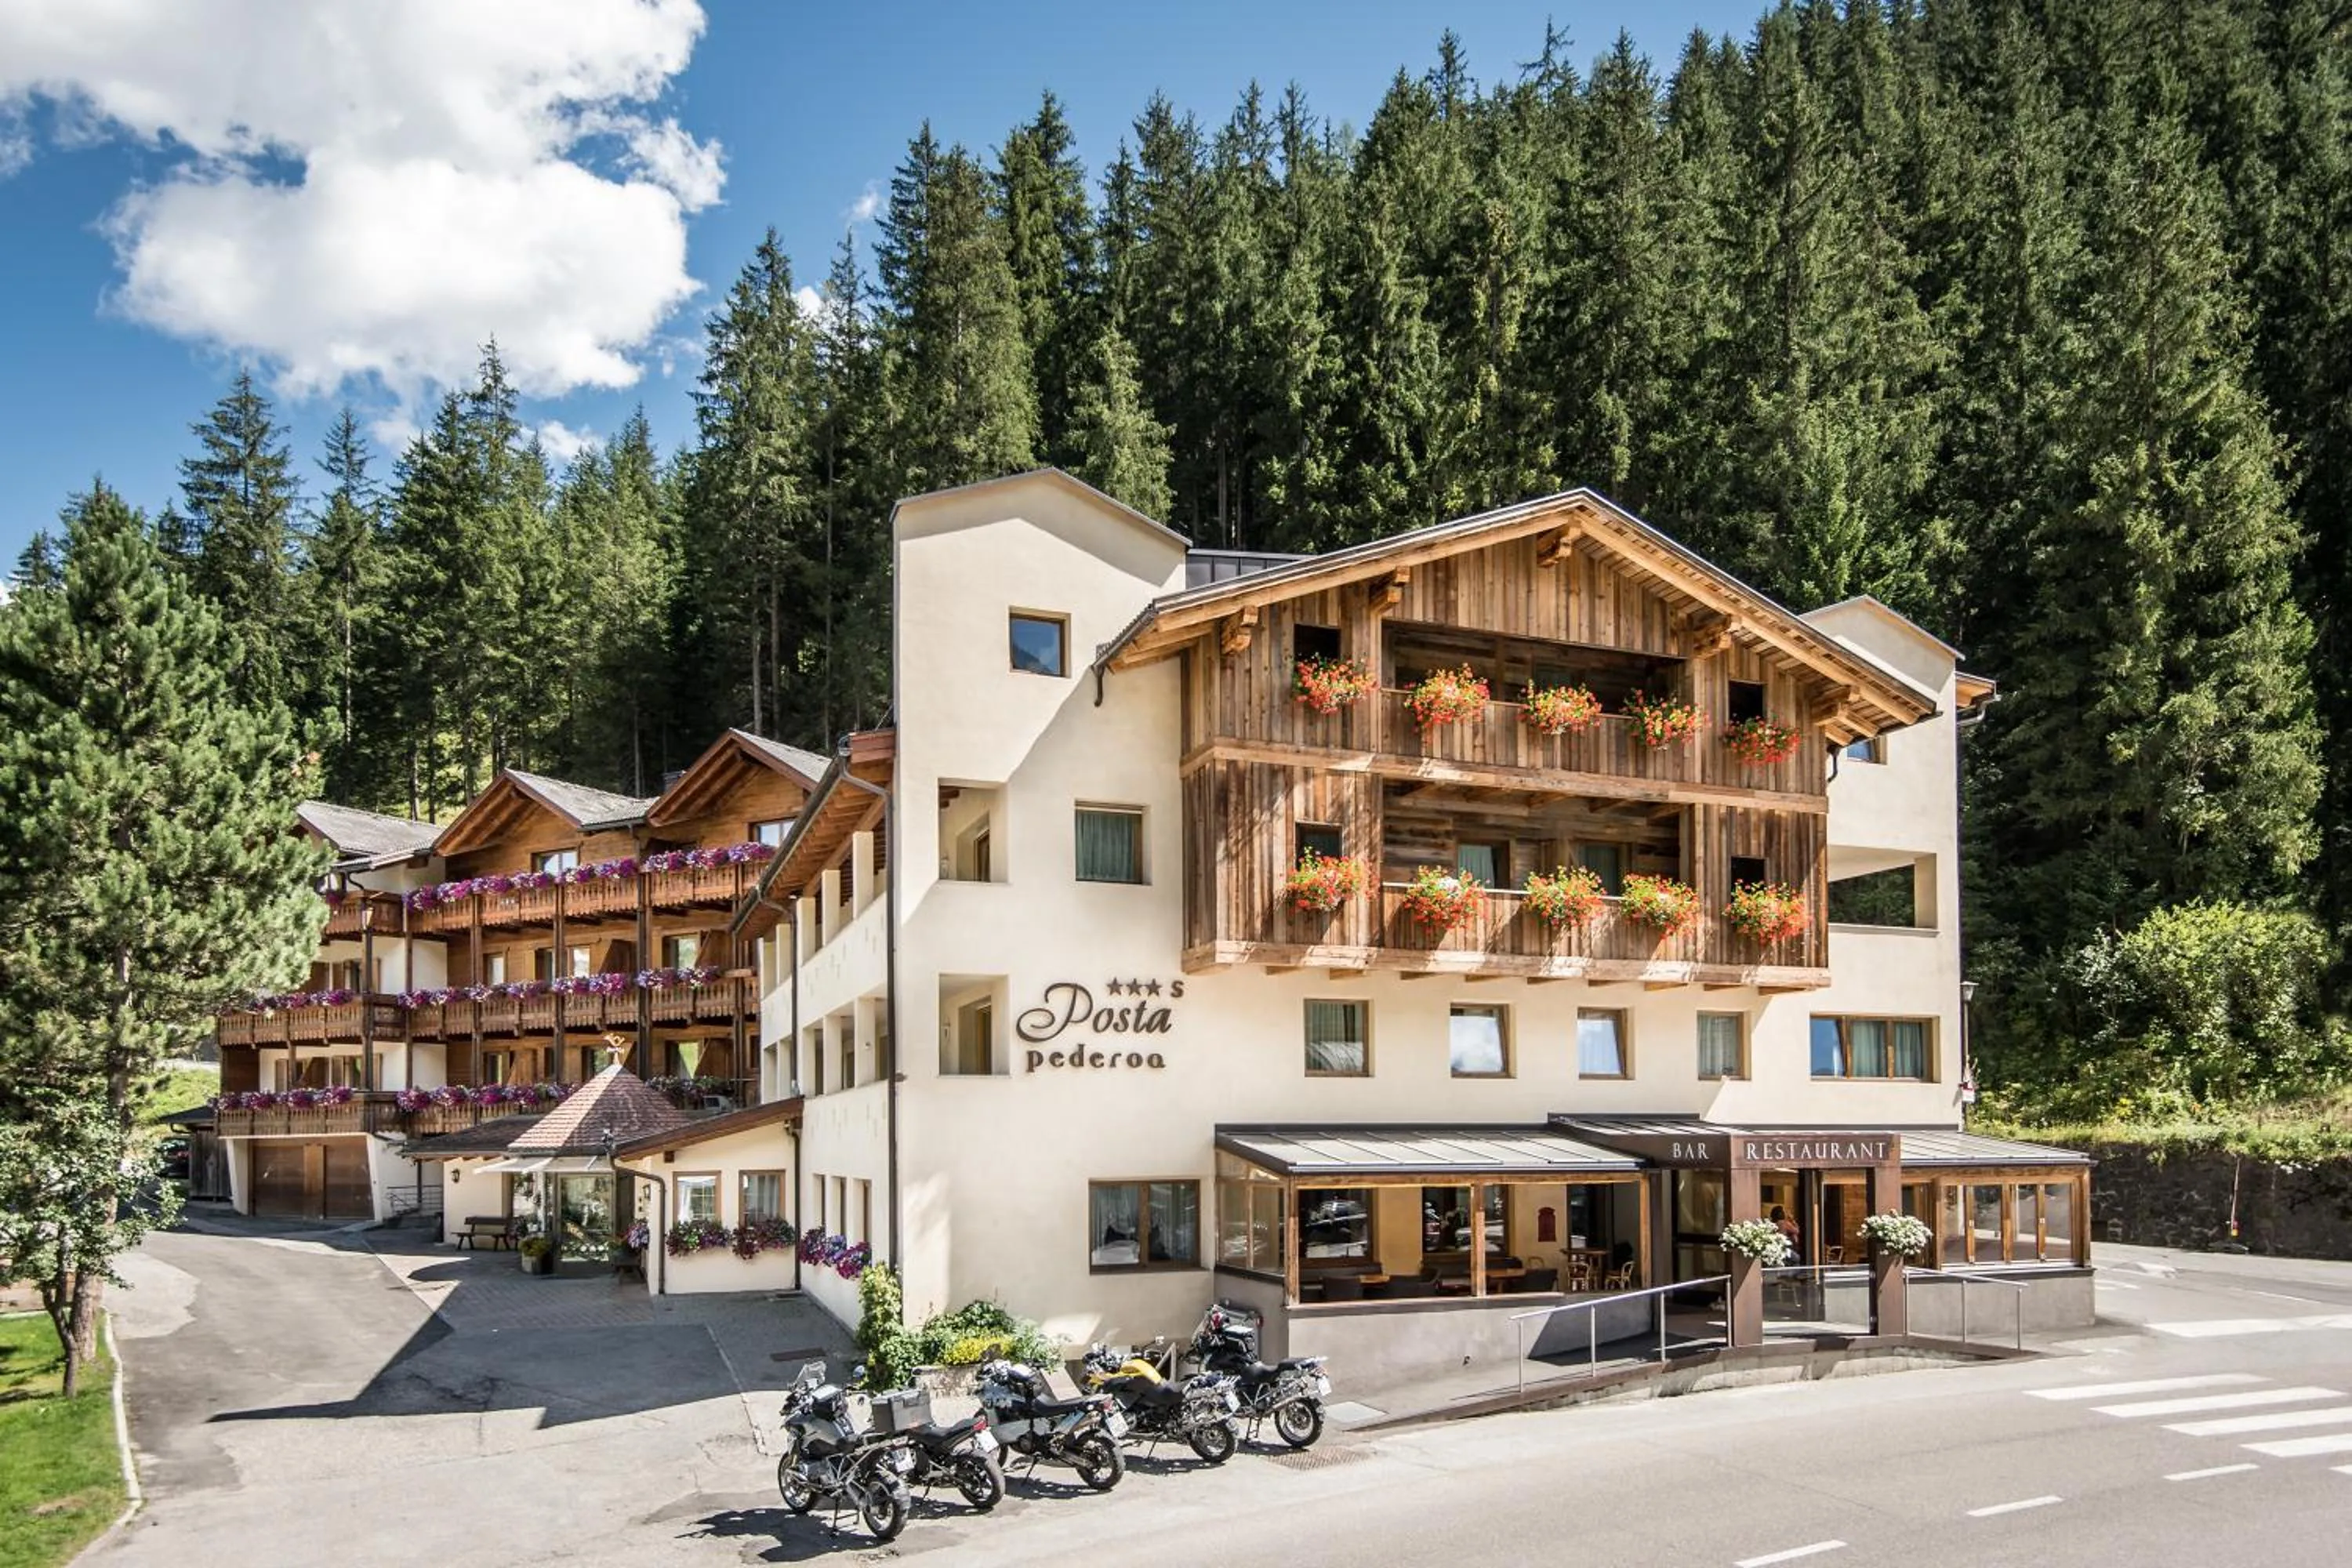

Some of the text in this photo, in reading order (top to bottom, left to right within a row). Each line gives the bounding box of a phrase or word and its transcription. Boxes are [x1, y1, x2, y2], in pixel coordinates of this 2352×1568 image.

[1016, 982, 1172, 1042] Posta
[1025, 1044, 1166, 1073] pederoa
[1671, 1142, 1886, 1160] BAR RESTAURANT
